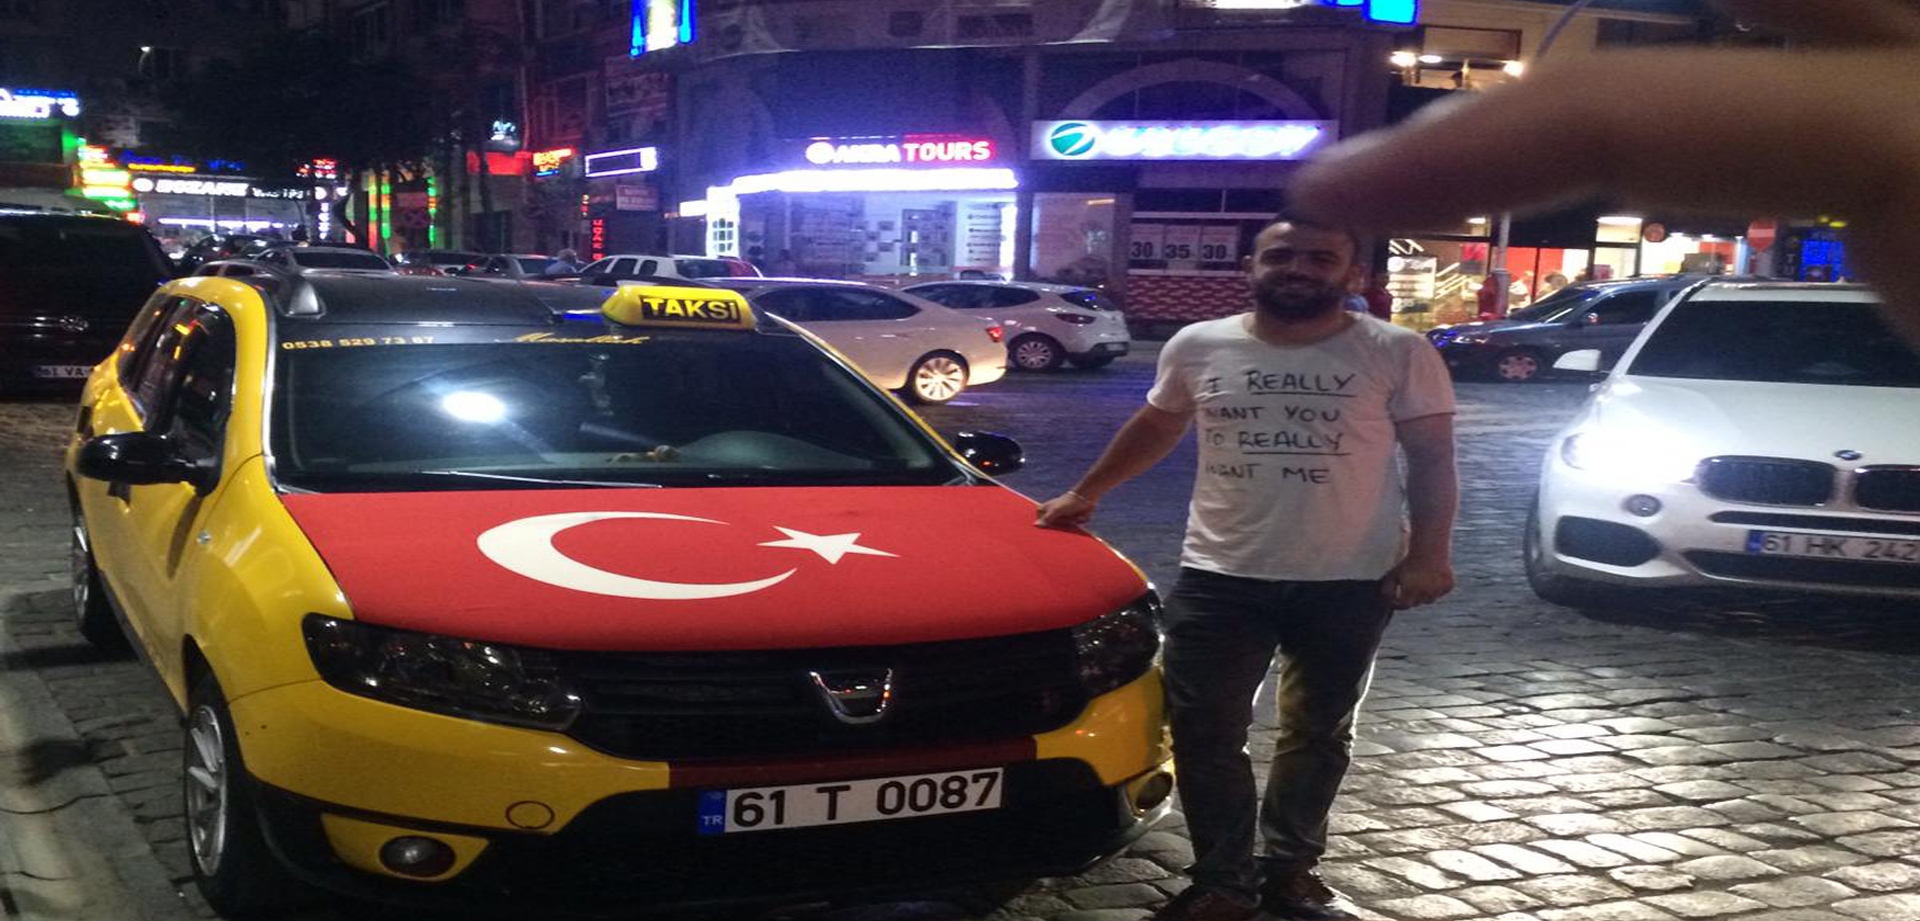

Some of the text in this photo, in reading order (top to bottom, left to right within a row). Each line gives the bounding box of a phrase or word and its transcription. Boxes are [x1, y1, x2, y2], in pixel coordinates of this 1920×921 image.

[903, 140, 991, 161] TOURS
[1131, 241, 1154, 258] 30
[1165, 244, 1191, 259] 35
[1203, 244, 1227, 260] 30
[1206, 370, 1356, 394] I REALLY
[1204, 405, 1340, 422] WANT YOU
[1205, 428, 1343, 451] TO REALLY
[1205, 463, 1331, 484] WANT ME
[1765, 534, 1791, 552] 61
[1862, 541, 1919, 561] 242
[703, 771, 999, 828] TR 61 T 0087
